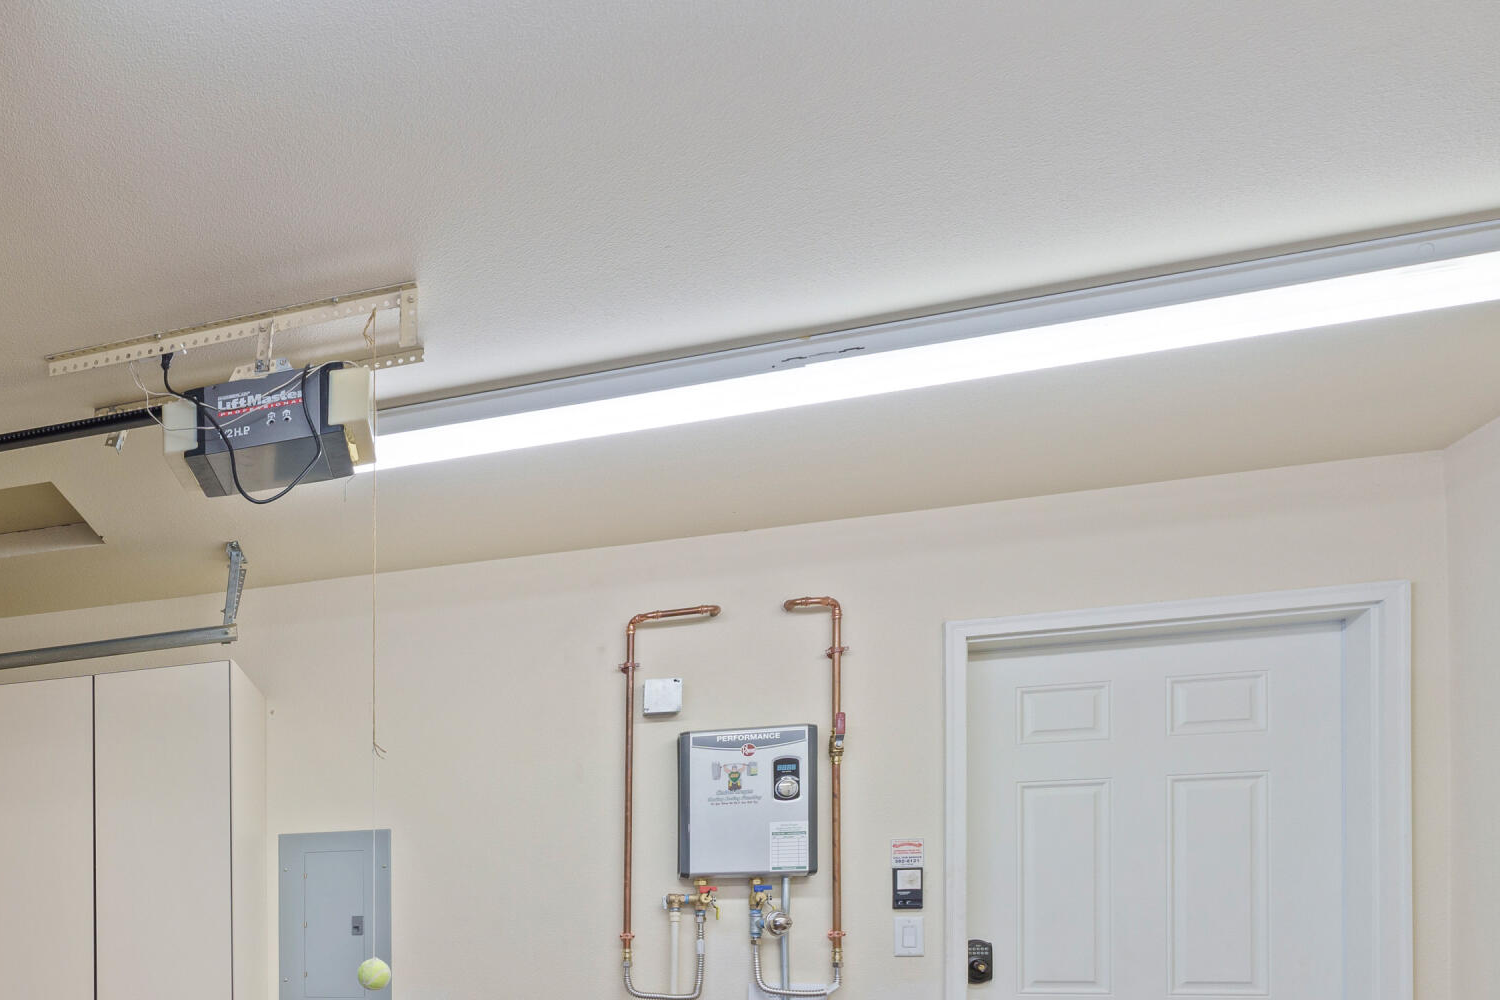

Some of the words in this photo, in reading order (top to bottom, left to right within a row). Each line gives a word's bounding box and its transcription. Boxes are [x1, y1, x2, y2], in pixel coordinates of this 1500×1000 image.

[218, 389, 303, 411] LiftMaster
[220, 399, 303, 417] PROFEIONAL
[716, 732, 780, 742] PERFORMANCE
